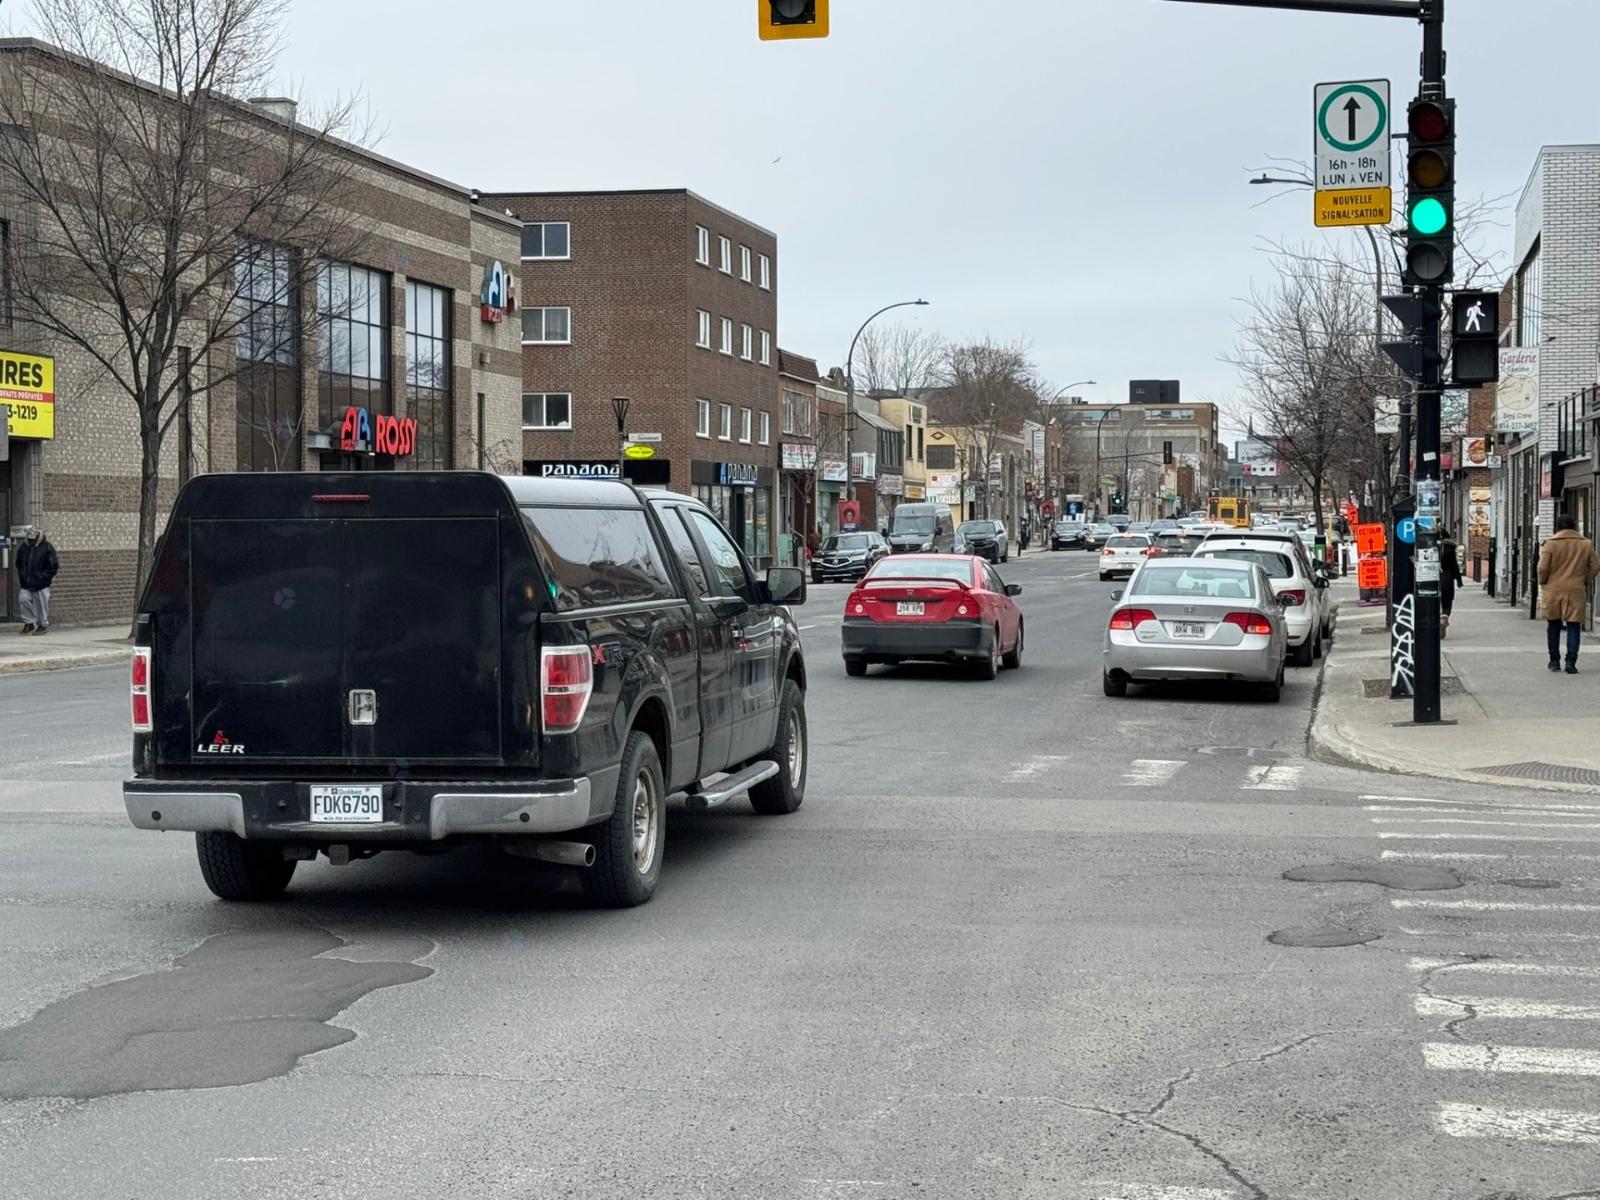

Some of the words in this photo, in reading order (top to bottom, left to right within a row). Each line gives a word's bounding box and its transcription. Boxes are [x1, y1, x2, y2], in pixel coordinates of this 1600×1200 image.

[1329, 159, 1347, 170] 16h
[1358, 157, 1376, 168] 18h
[1322, 174, 1345, 185] LUN
[1359, 171, 1383, 183] VEN
[1333, 195, 1373, 205] NOUVELLE
[1321, 208, 1384, 220] SIGNALISATION
[1500, 350, 1537, 366] Garderie
[376, 415, 418, 455] ROSSY
[197, 744, 245, 754] LEER
[314, 795, 379, 814] FDK6790
